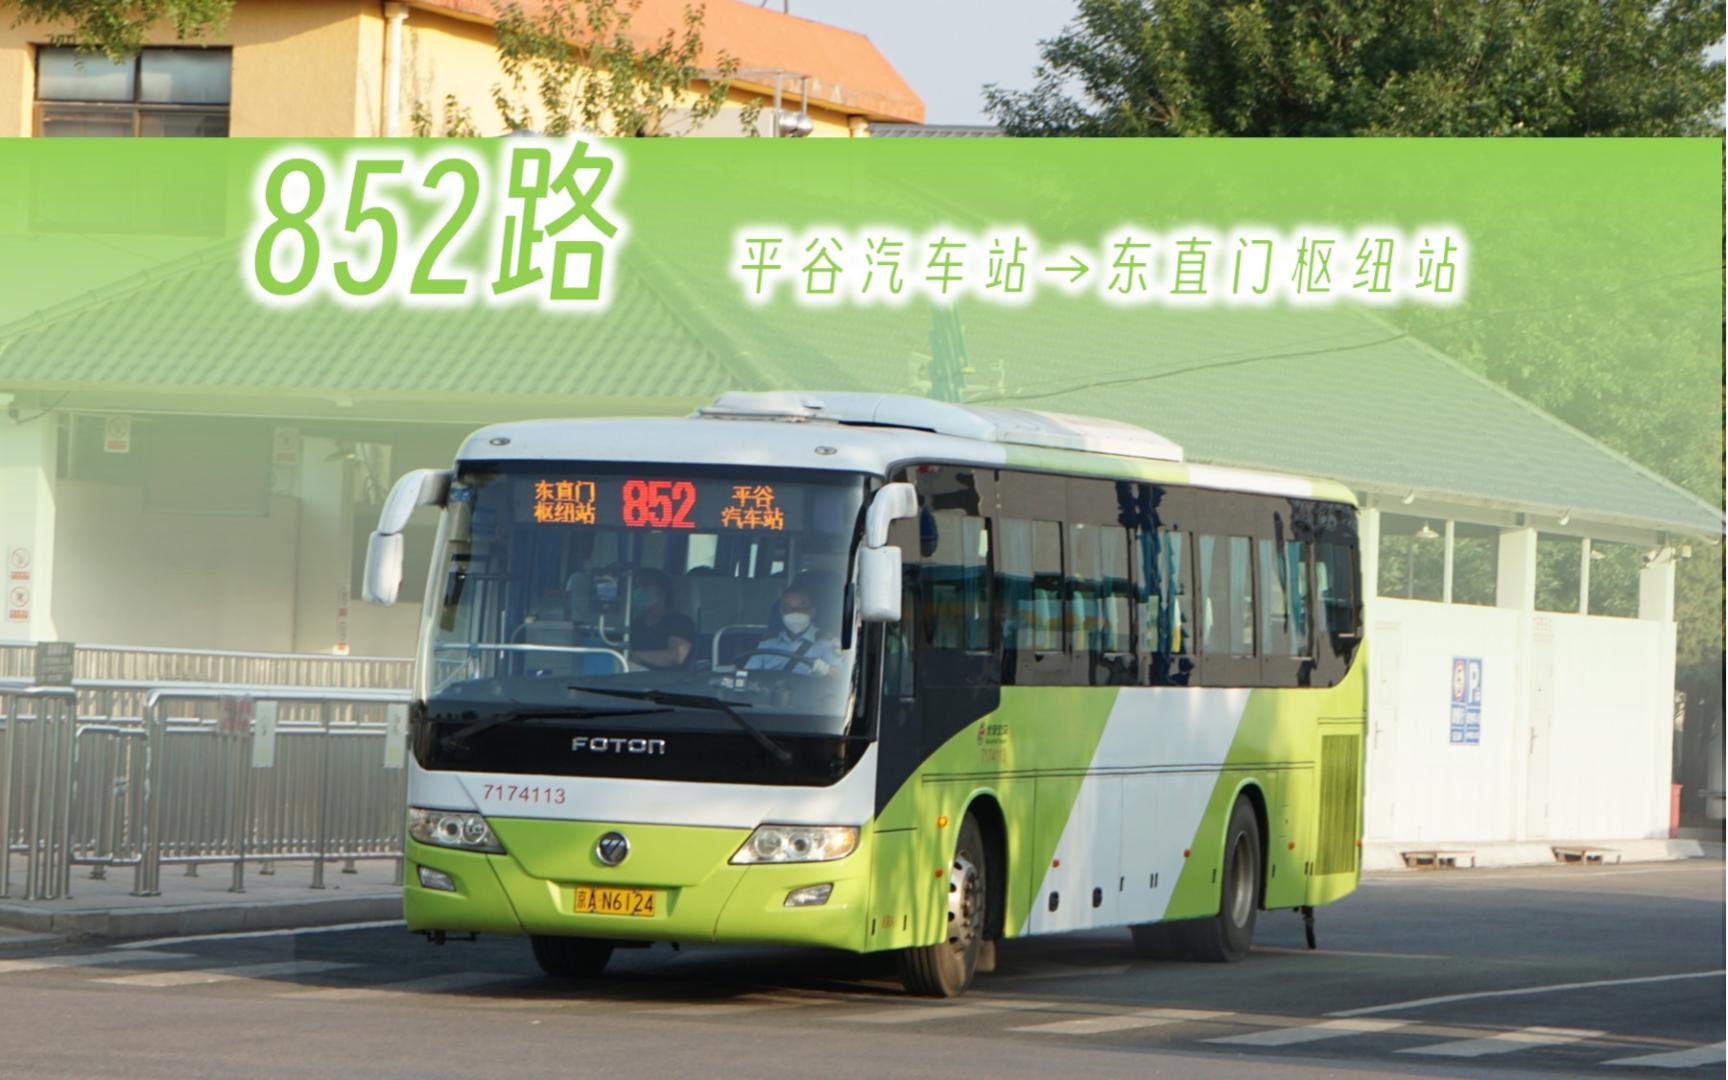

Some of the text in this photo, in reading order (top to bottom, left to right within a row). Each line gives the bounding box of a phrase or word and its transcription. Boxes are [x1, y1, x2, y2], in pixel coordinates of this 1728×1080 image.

[534, 479, 596, 502] 东直门
[731, 485, 775, 508] 平谷
[533, 502, 596, 525] 枢纽站
[622, 480, 697, 529] 852
[721, 506, 785, 531] 汽车站
[571, 736, 666, 755] FOTON
[483, 784, 566, 804] 7174113
